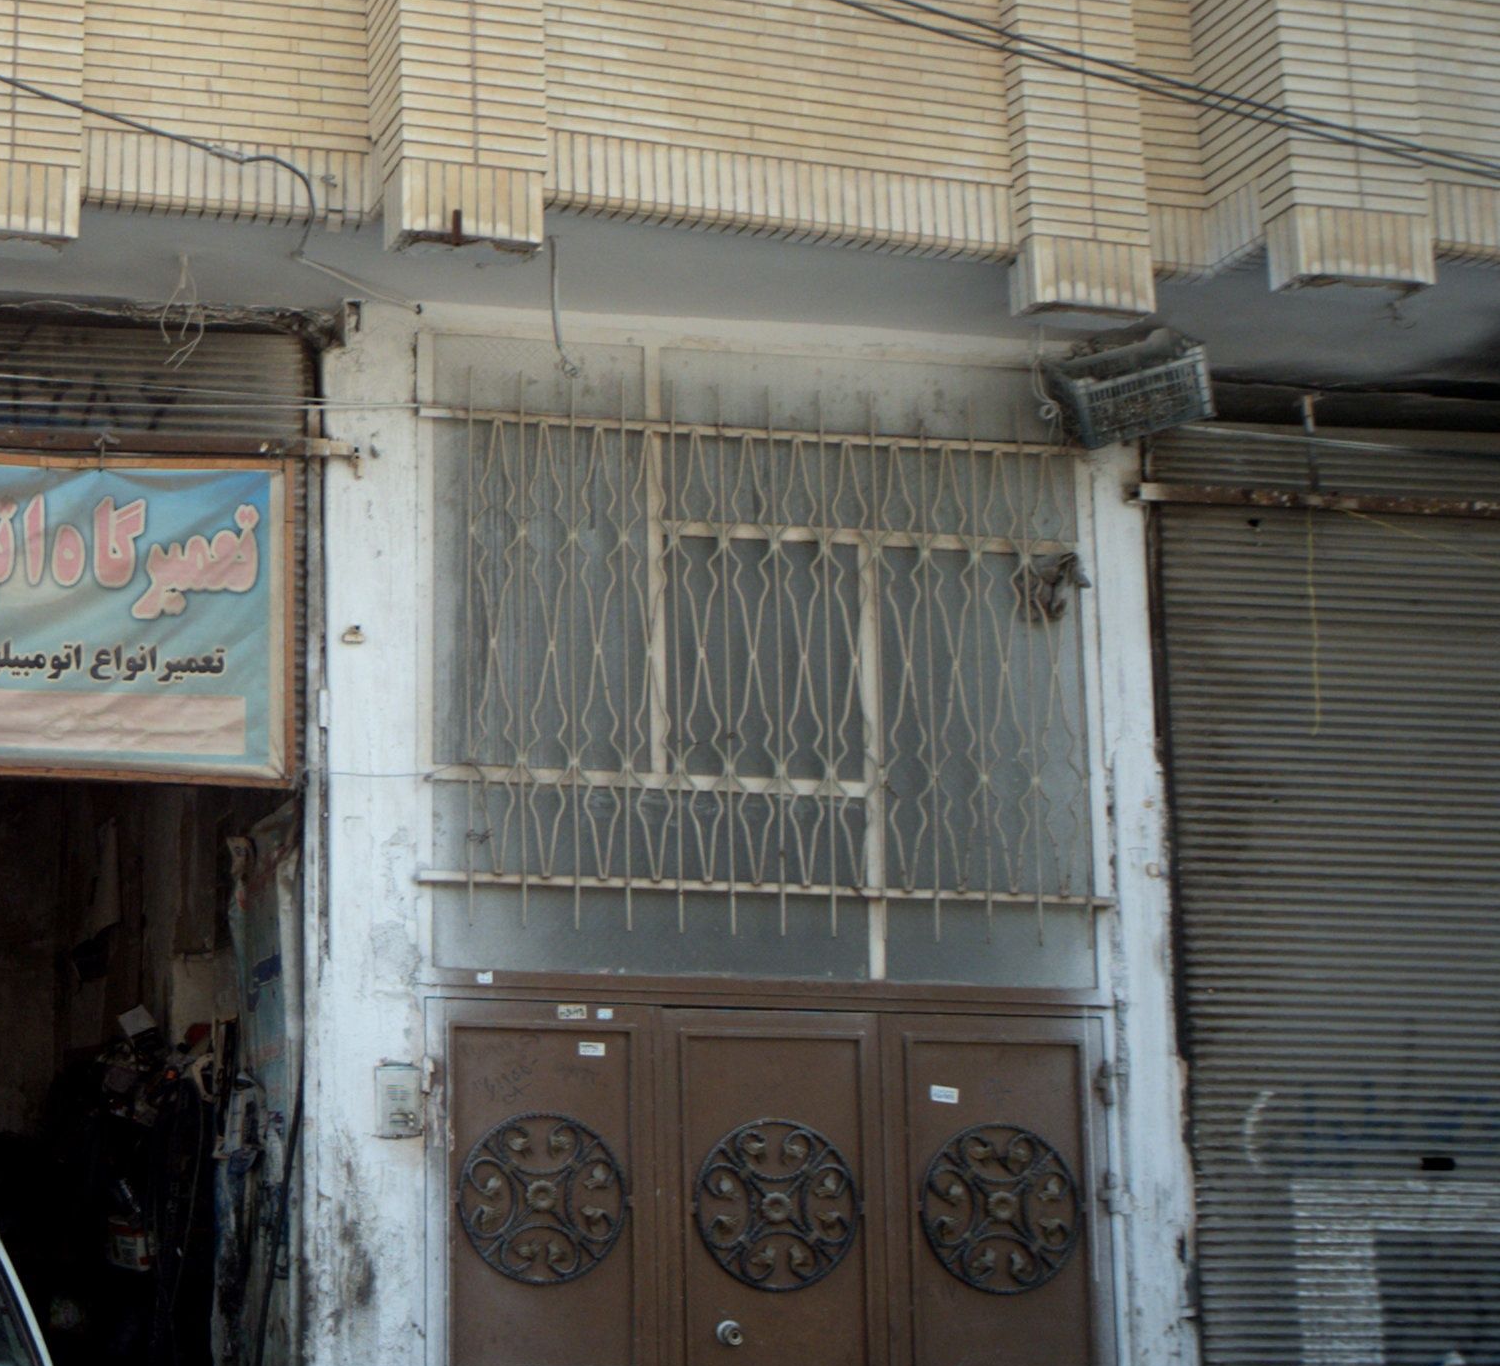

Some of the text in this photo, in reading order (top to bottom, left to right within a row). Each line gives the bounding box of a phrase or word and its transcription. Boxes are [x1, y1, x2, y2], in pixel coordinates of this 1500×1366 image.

[51, 495, 261, 620] تعمیرگاه
[90, 644, 158, 681] انواع
[159, 647, 226, 682] تعمیر
